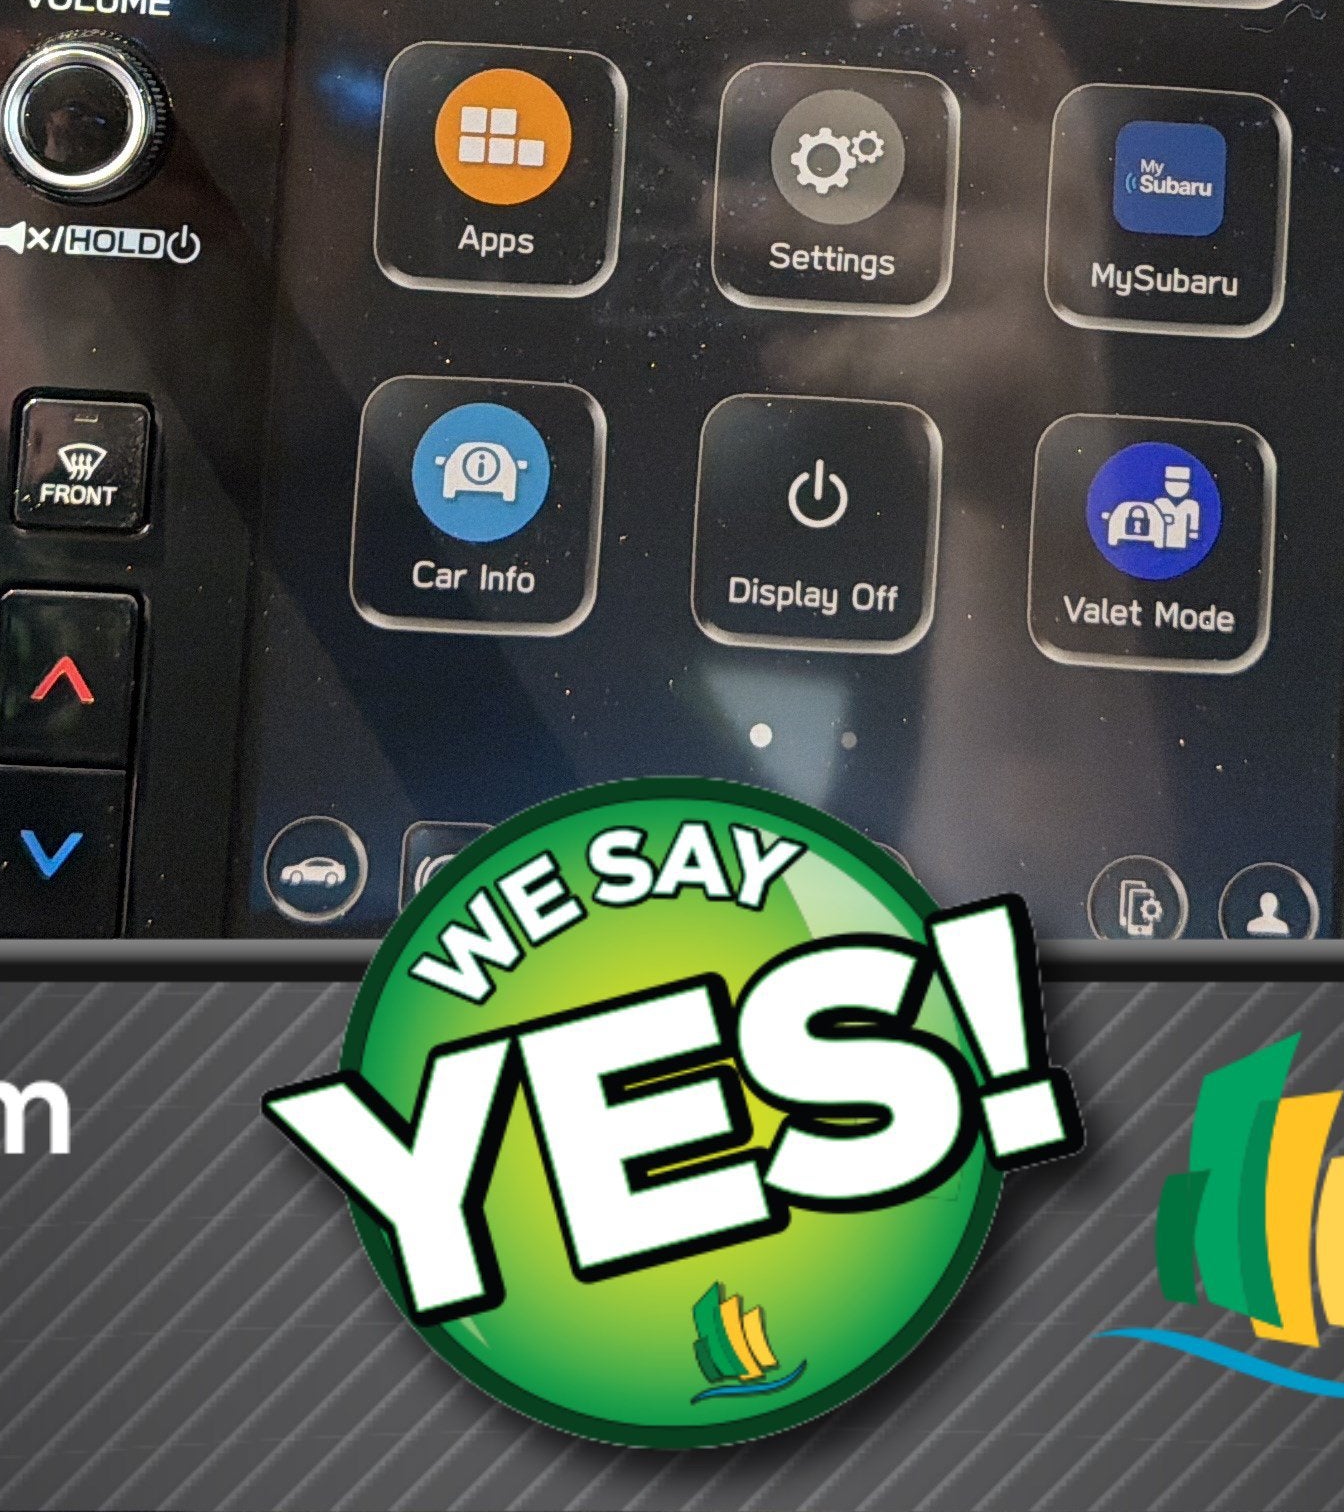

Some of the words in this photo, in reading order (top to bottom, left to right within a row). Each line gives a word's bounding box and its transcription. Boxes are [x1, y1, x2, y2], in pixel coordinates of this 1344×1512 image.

[1140, 158, 1165, 177] My
[1139, 174, 1213, 197] Subaru
[457, 224, 535, 259] Apps
[769, 242, 896, 281] Settings
[1091, 261, 1238, 297] MySubaru
[39, 482, 118, 507] FRONT
[412, 560, 468, 590] Car
[479, 563, 535, 594] Info
[728, 576, 838, 616] Display
[851, 582, 899, 612] Off
[1063, 595, 1143, 627] Valet
[1154, 600, 1235, 633] Mode
